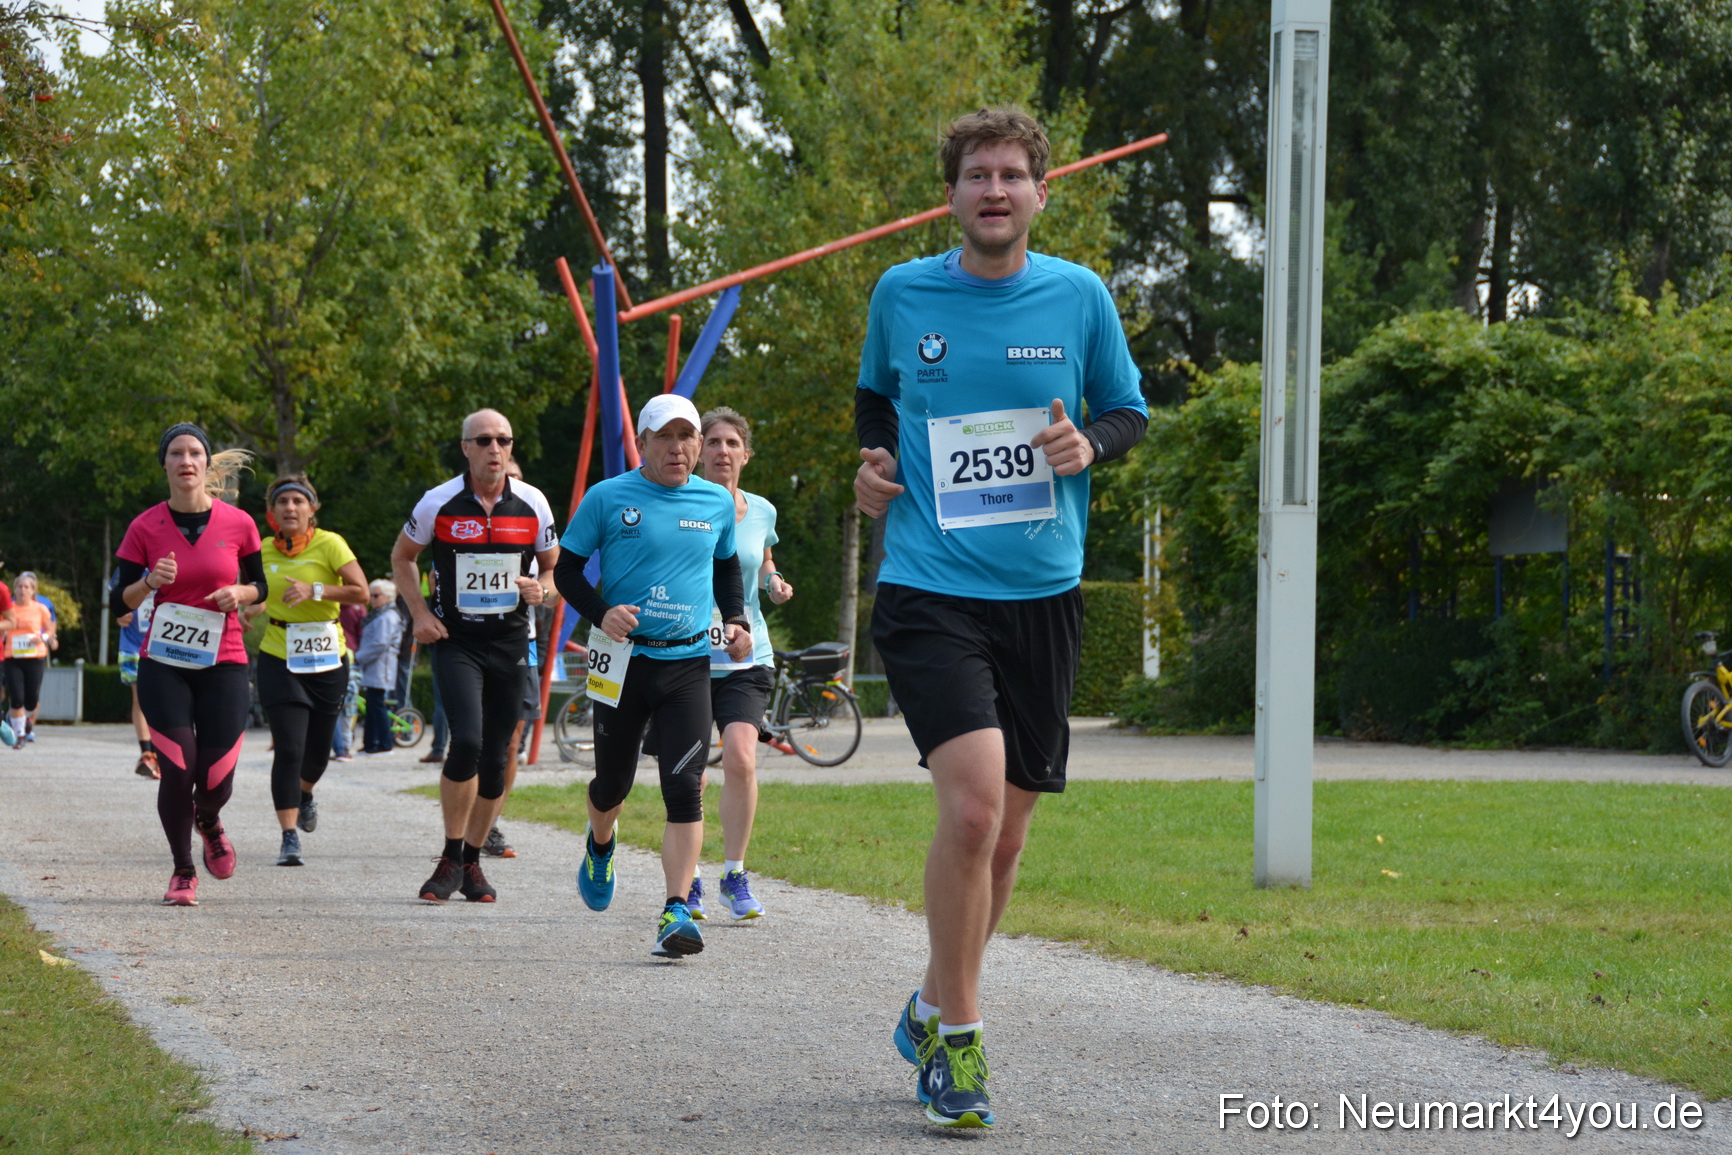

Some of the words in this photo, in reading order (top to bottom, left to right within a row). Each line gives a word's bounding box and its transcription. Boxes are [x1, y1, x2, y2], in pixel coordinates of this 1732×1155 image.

[920, 334, 946, 345] BMW
[1006, 346, 1066, 360] BOCK
[917, 368, 948, 377] PARTL
[974, 420, 1015, 434] BOCK
[950, 443, 1035, 485] 2539
[940, 481, 946, 489] D
[980, 493, 1014, 506] Thore
[679, 519, 712, 531] BOCK
[466, 572, 508, 590] 2141
[649, 585, 670, 600] 18.
[480, 596, 498, 604] Klaus
[646, 599, 692, 611] Neumarkter
[643, 608, 682, 621] Stadtlauf
[161, 621, 209, 647] 2274
[294, 637, 331, 653] 2432
